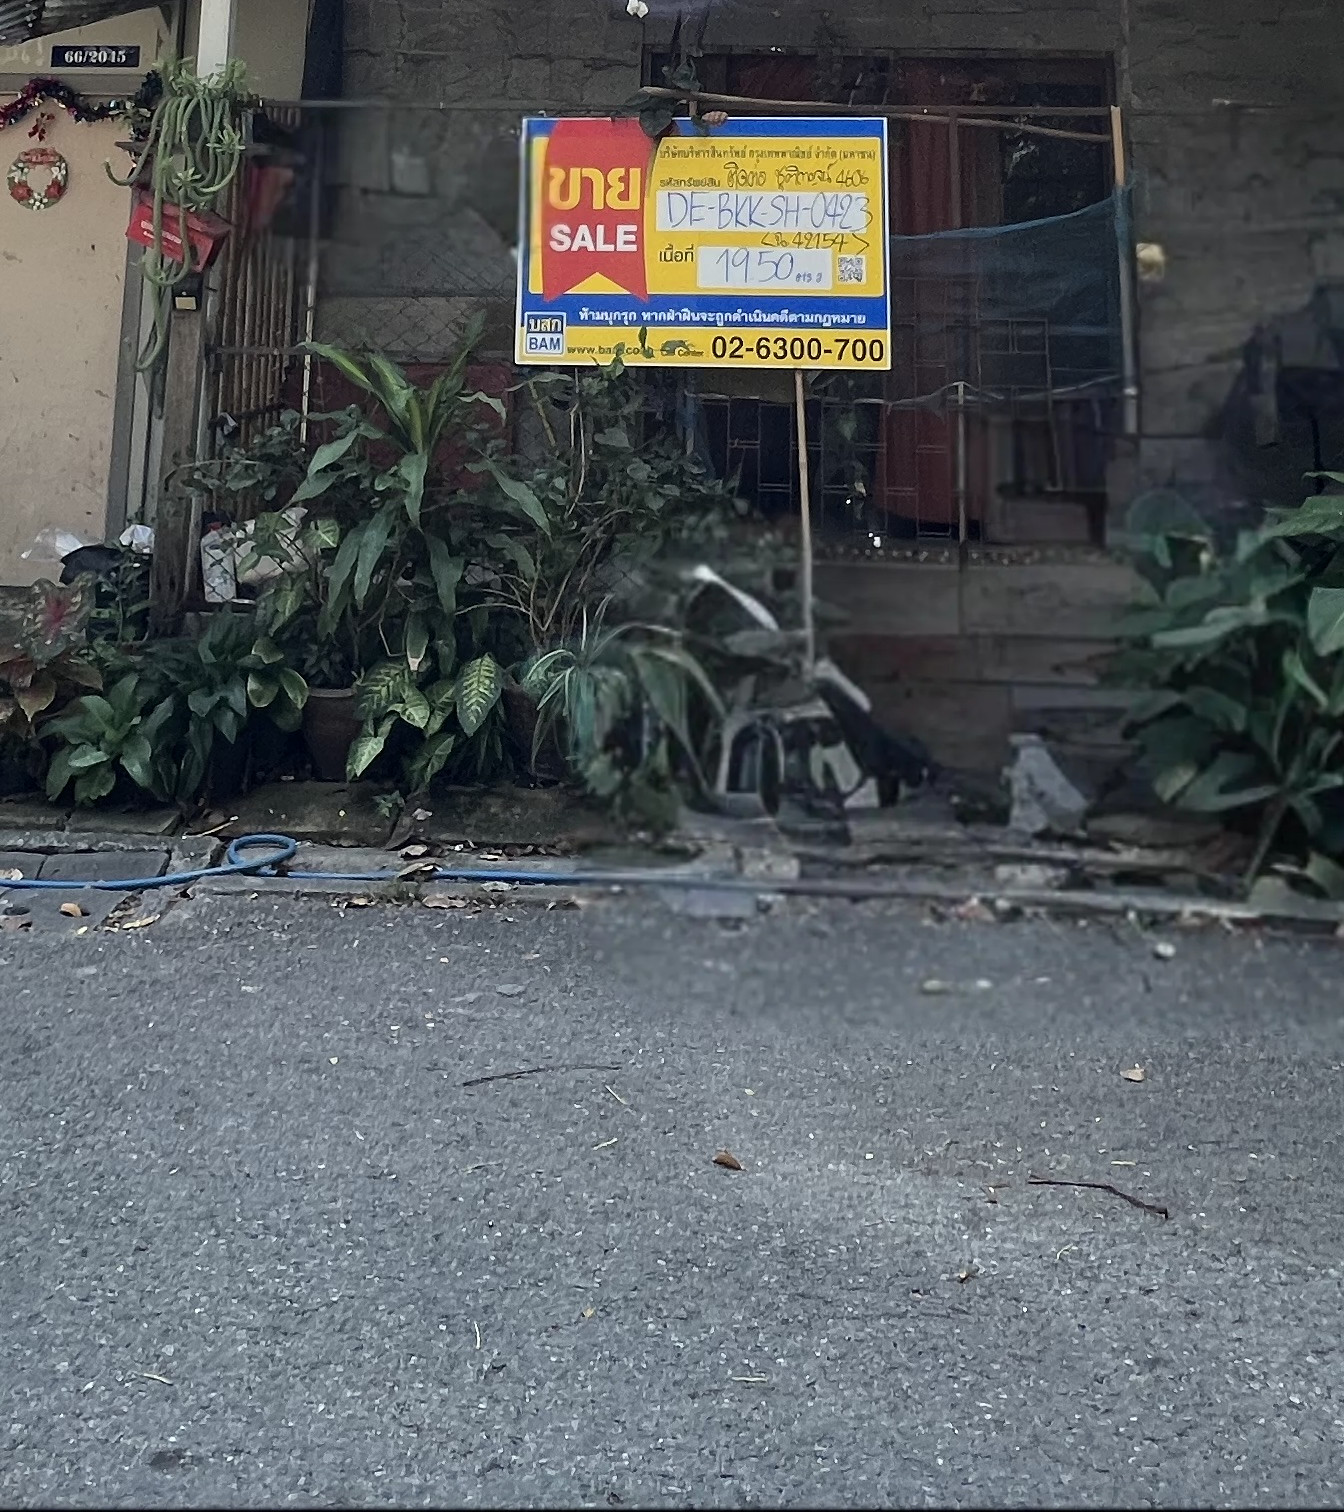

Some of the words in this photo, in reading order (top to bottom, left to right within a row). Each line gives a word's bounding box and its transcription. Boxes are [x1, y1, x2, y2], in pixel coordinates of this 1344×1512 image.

[815, 145, 837, 159] จำกัด
[839, 149, 876, 161] (มหาชน)
[548, 166, 641, 210] ขาย
[659, 176, 721, 188] รหัสทรัพย์สิน
[667, 192, 873, 232] DE-BKK-SH-0423
[549, 224, 638, 252] SALE
[659, 244, 694, 263] เนื้อที่
[529, 317, 562, 332] บสก
[579, 307, 637, 326] ห้ามบุกรุก
[642, 308, 866, 327] หากฝ่าฝืนจะถูกดำเนินคดีตามกฎหมาย
[529, 337, 561, 351] BAM
[711, 335, 884, 362] 02-6300-700
